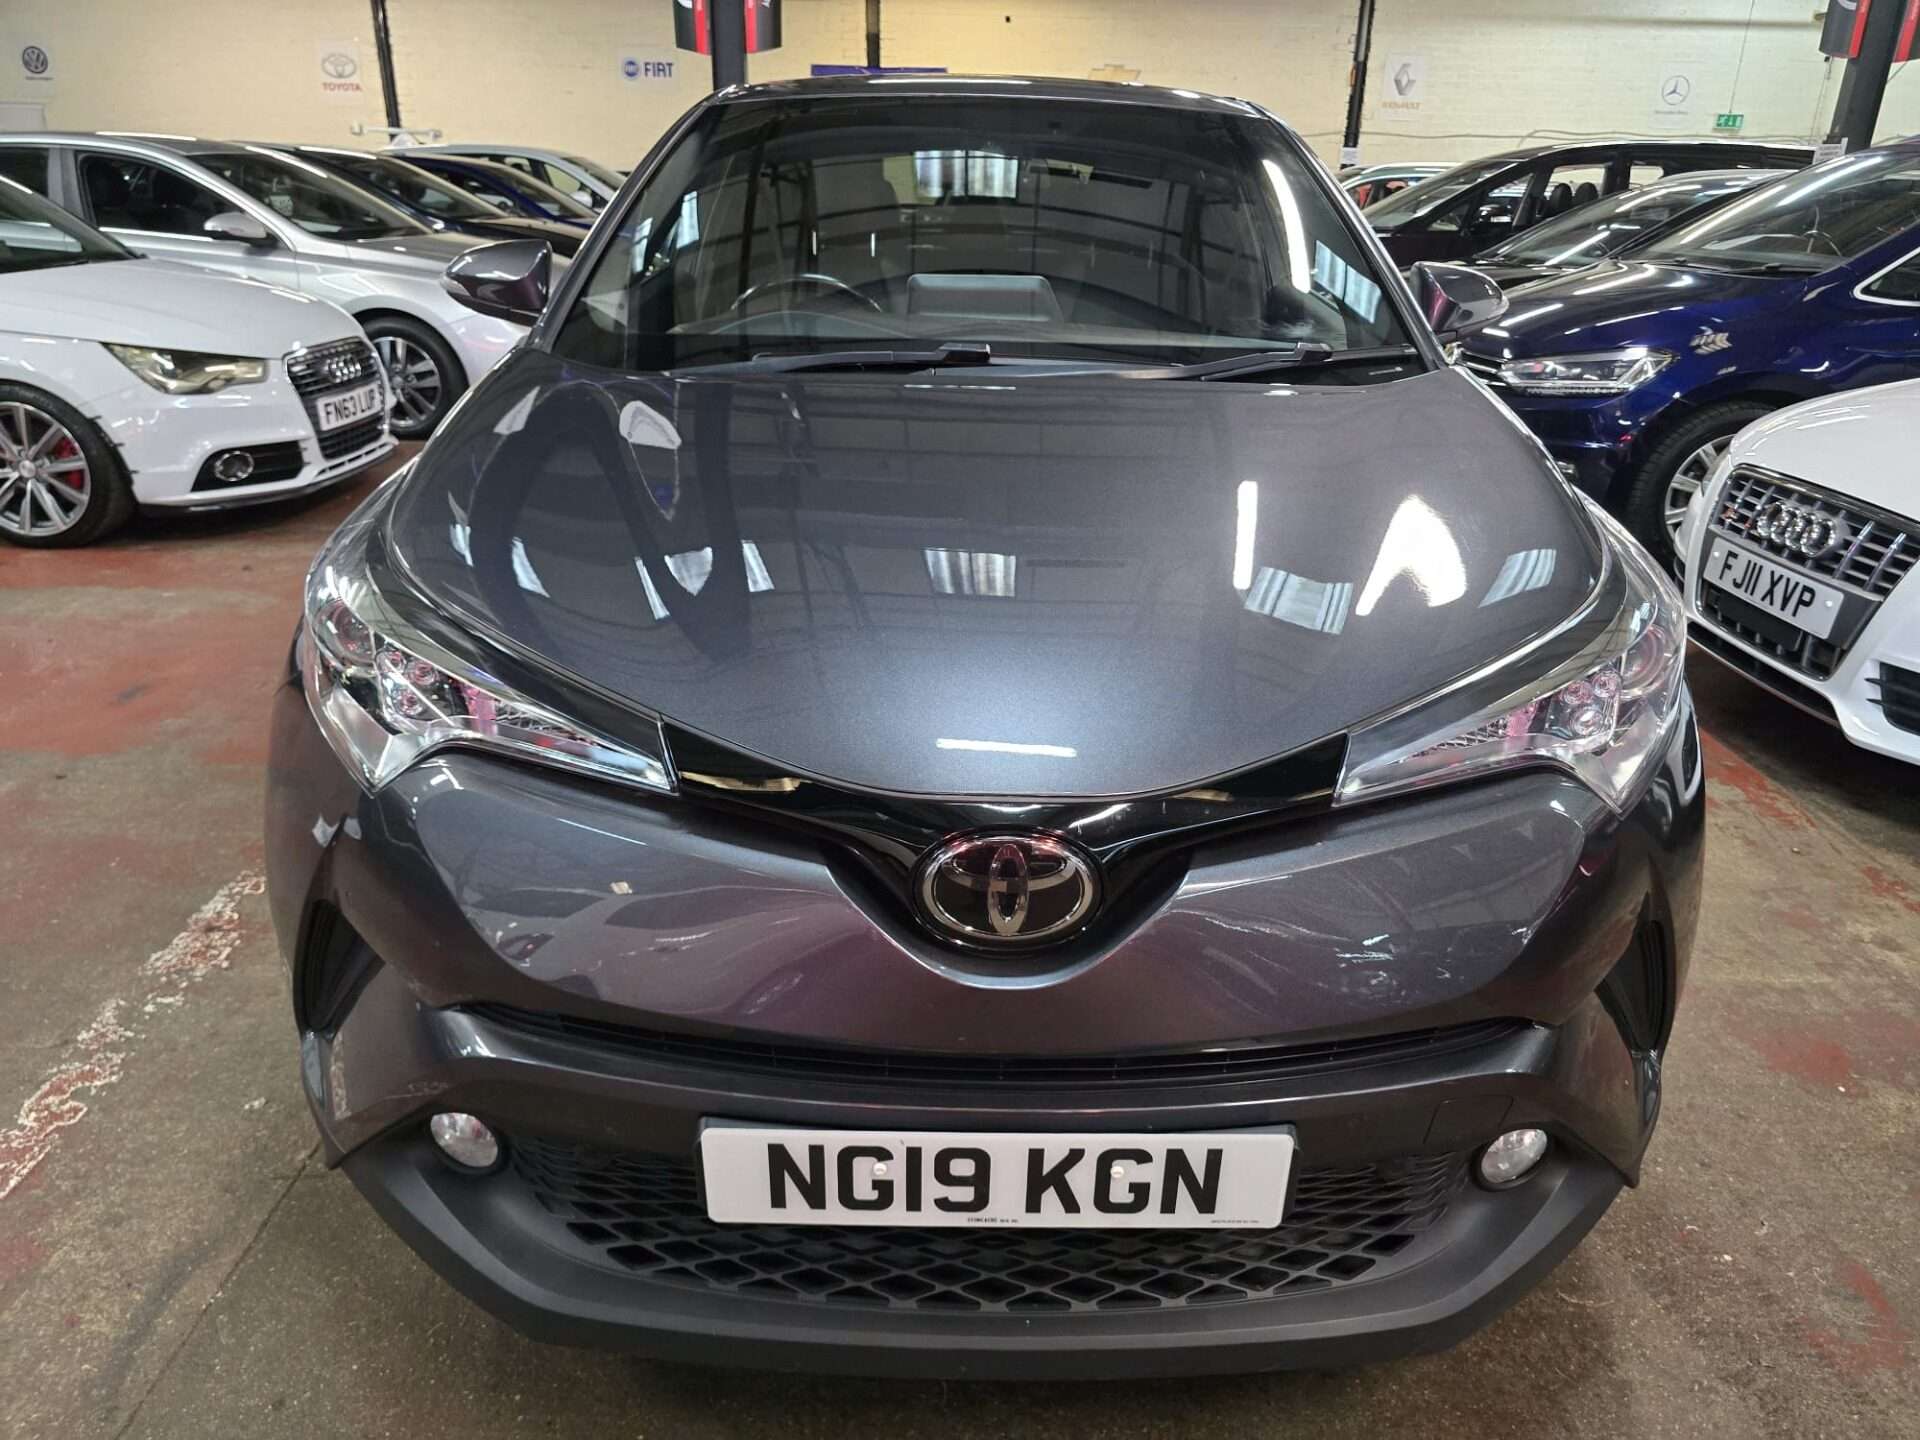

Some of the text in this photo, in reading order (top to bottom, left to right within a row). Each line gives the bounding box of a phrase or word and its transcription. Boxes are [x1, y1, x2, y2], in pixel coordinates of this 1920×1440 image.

[322, 82, 362, 92] TOYOTA
[644, 62, 674, 78] FIAT
[1718, 549, 1816, 618] FJ11 XVP
[767, 1143, 1224, 1214] NG19 KGN
